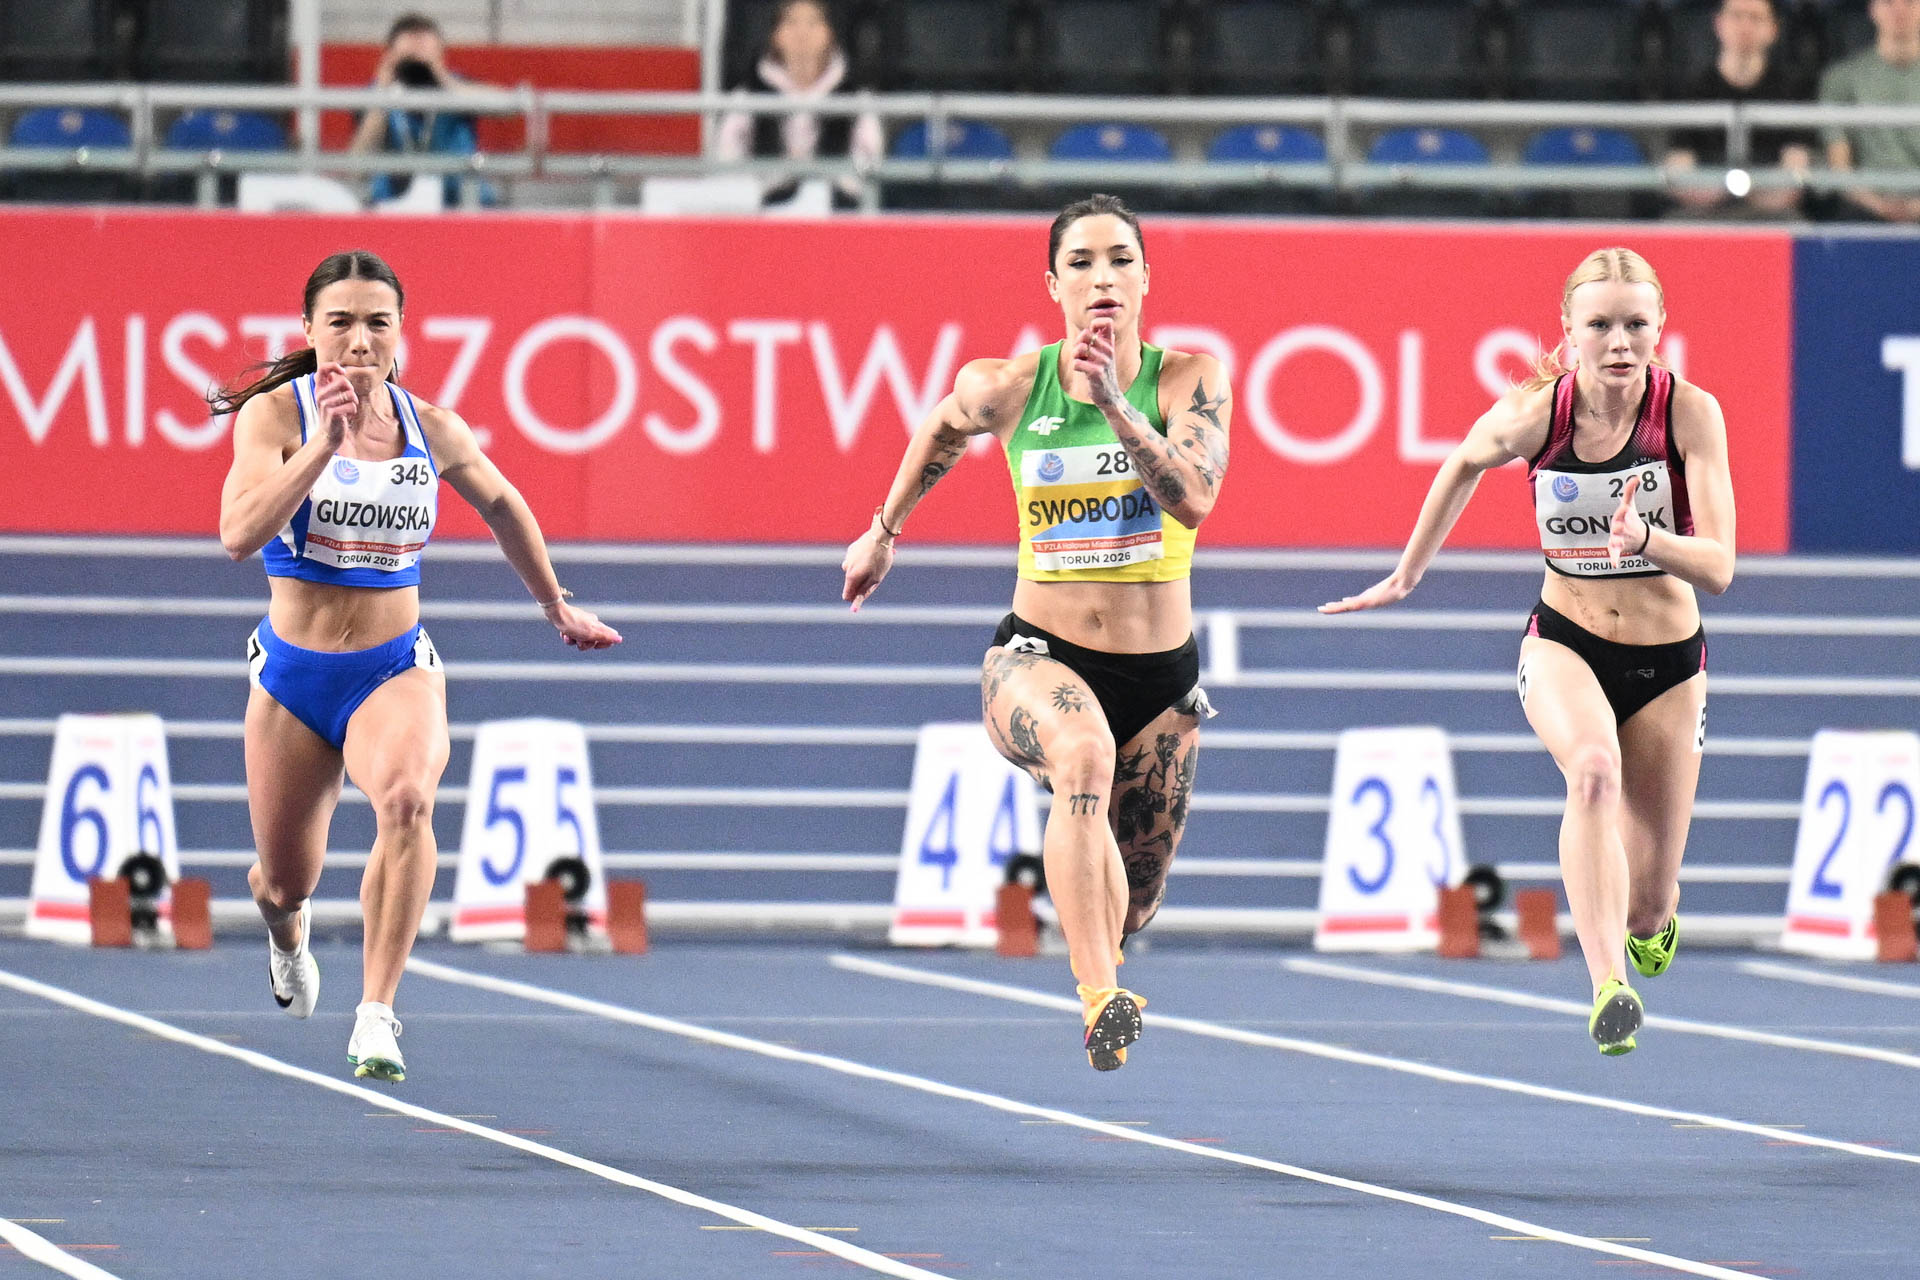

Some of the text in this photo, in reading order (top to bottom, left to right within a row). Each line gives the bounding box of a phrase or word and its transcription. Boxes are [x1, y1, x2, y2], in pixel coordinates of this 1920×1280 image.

[1027, 415, 1065, 436] 4F
[390, 464, 429, 486] 345
[1096, 451, 1136, 476] 28
[316, 499, 430, 531] GUZOWSKA
[1028, 492, 1155, 527] SWOBODA
[336, 553, 400, 567] TORUŃ 2026
[1061, 551, 1131, 565] TORUŃ 2026
[1560, 549, 1578, 557] PZLA
[1579, 549, 1608, 557] Halowe
[1620, 558, 1650, 569] 2026
[1069, 793, 1100, 817] 777
[60, 763, 111, 885] 6
[481, 767, 527, 887] 5
[918, 771, 1021, 892] 4 4
[1346, 774, 1451, 895] 3 3
[1809, 780, 1852, 899] 2
